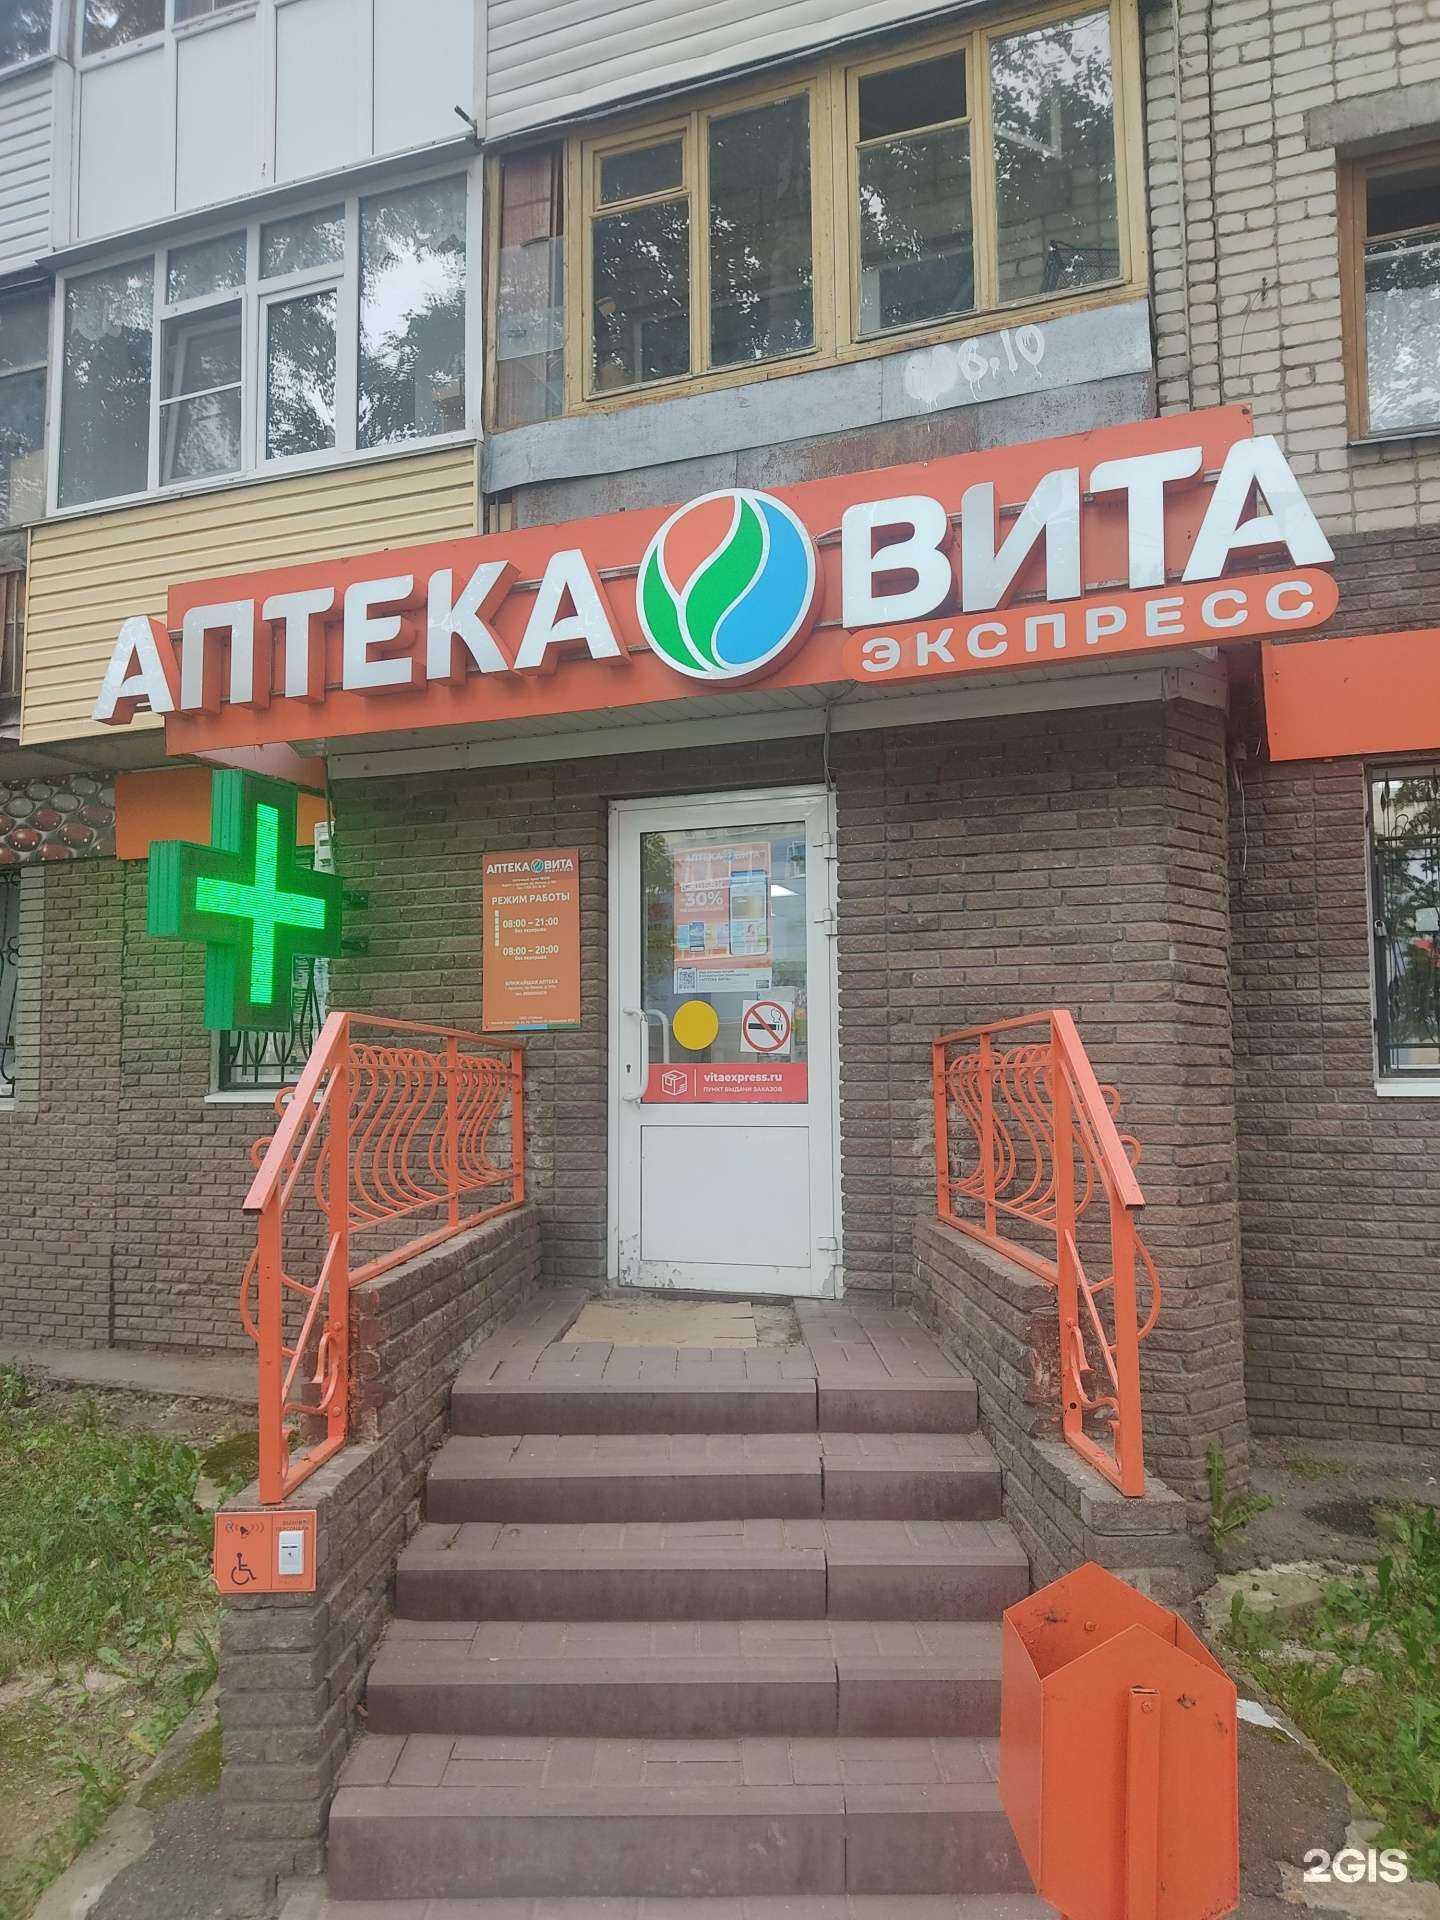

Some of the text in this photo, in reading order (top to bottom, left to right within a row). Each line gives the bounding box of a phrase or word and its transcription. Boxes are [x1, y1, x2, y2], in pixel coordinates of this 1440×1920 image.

[91, 435, 1336, 720] АПТЕКА ВИТА
[861, 581, 1314, 673] ЭКСПРЕСС
[486, 858, 574, 874] АПТЕКА ВИТА
[491, 892, 570, 905] РЕЖИМ РАБОТЫ
[502, 919, 526, 928] 08:00
[535, 917, 559, 927] 21:00
[502, 946, 526, 956] 08:00
[535, 944, 559, 954] 20:00
[703, 1072, 783, 1083] vitaexpress.ru
